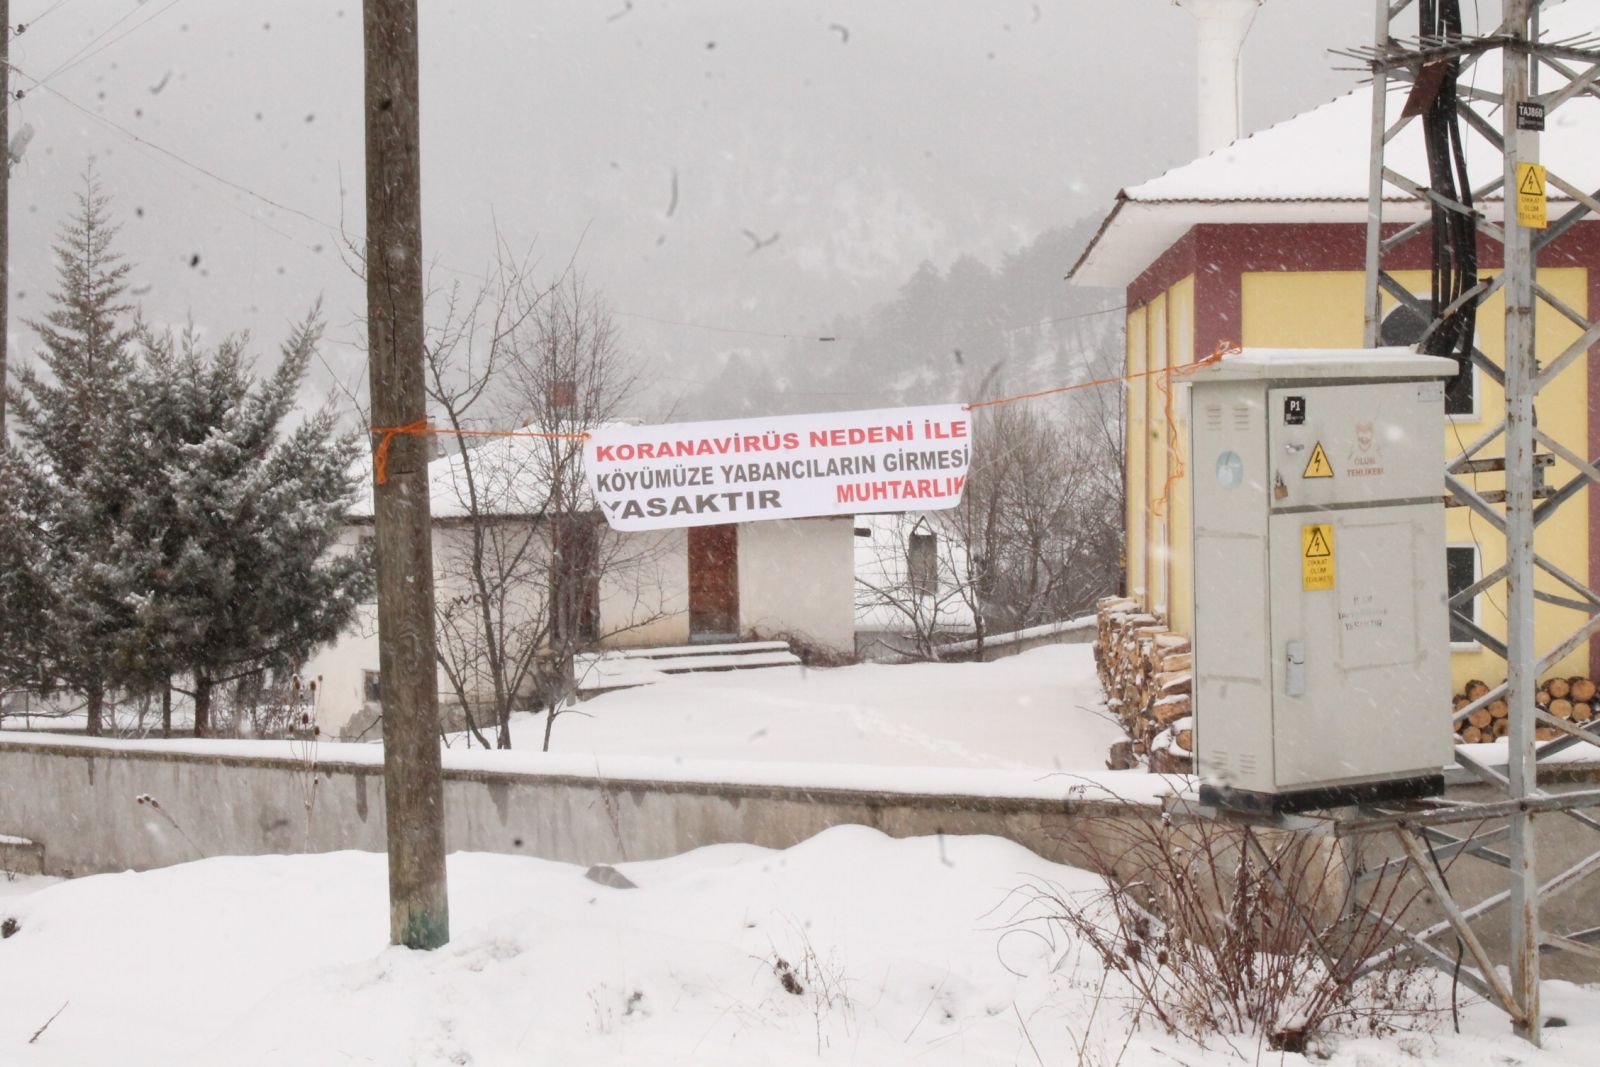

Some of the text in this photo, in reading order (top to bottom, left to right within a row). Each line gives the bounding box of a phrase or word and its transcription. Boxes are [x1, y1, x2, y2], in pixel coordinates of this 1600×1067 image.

[1290, 400, 1300, 411] P1
[596, 419, 968, 463] KORANAVİRÜS NEDENİ İLE
[596, 443, 969, 493] KÖYÜMÜZE YABANCILARIN GİRMESİ
[603, 489, 783, 520] YASAKTIR
